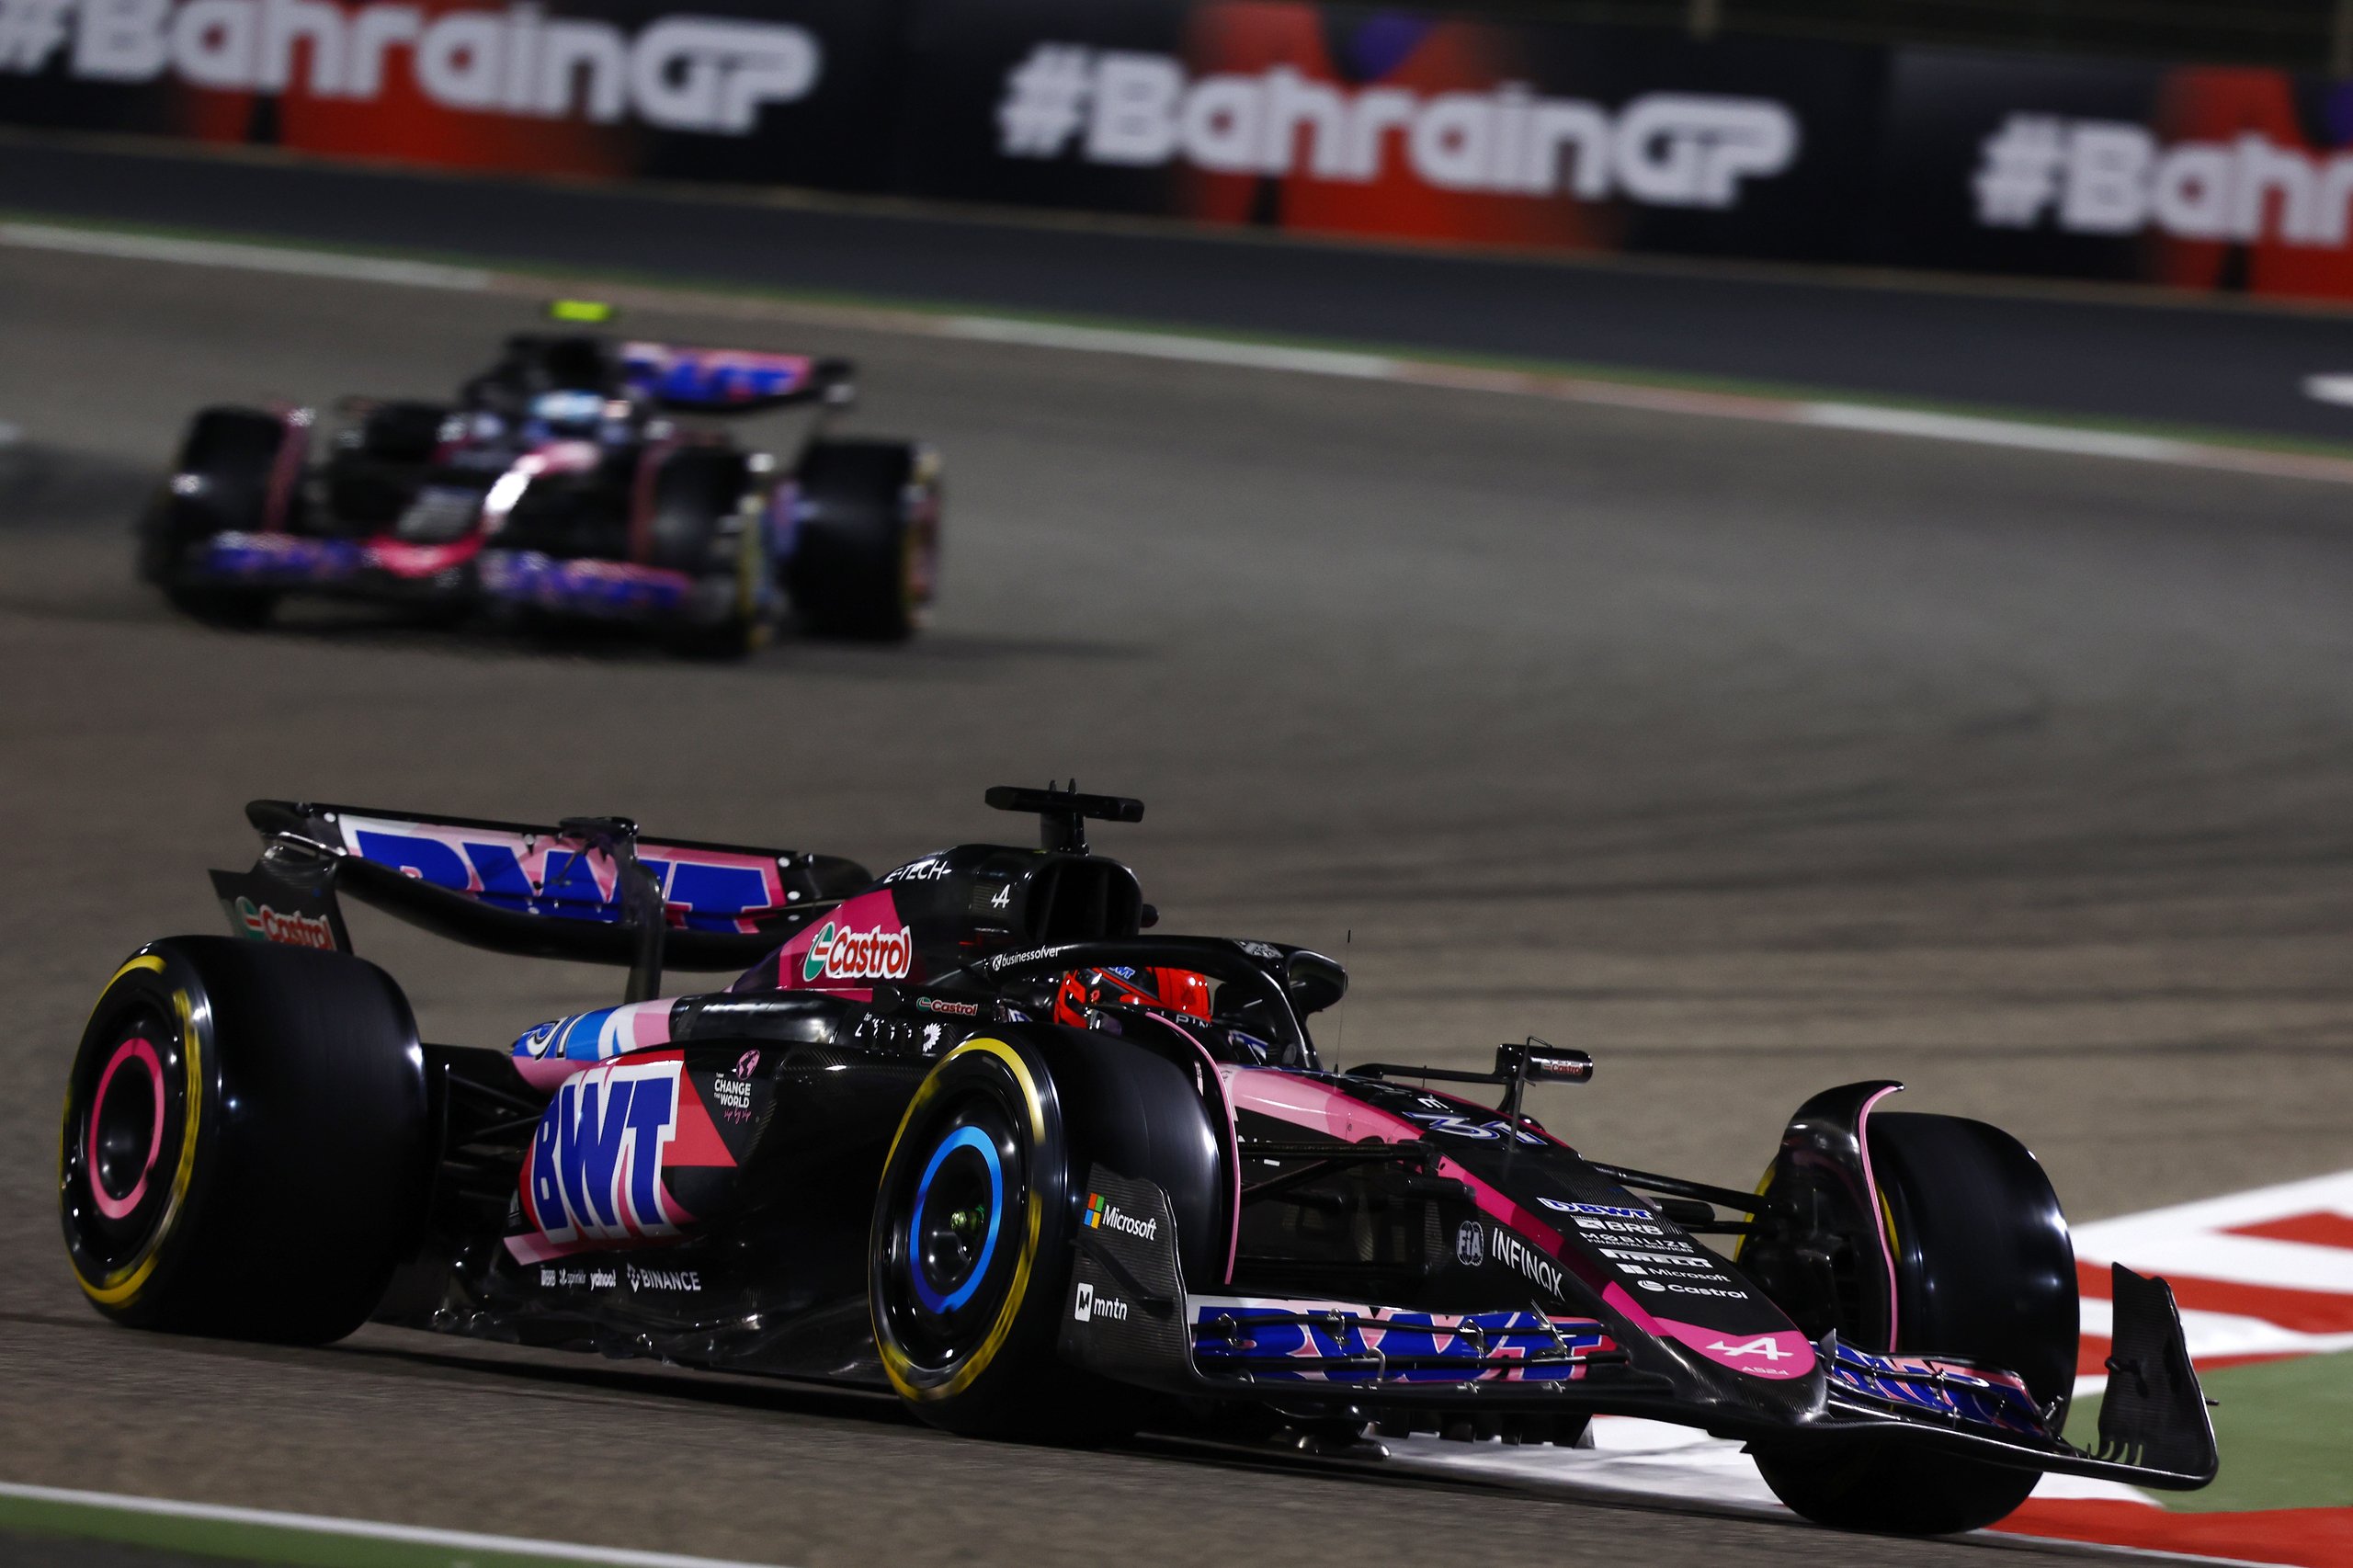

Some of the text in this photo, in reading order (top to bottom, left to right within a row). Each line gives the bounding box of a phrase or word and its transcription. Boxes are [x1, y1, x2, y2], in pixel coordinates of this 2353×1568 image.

[997, 41, 1797, 208] #BahrainGP
[260, 904, 337, 951] Castrol
[827, 925, 912, 980] Castrol
[1002, 945, 1059, 968] businessolver
[931, 999, 978, 1017] Castrol
[714, 1079, 751, 1096] CHANGE
[721, 1094, 749, 1108] WORLD
[1402, 1110, 1548, 1146] 31
[531, 1066, 680, 1238] BWT
[1102, 1204, 1157, 1241] Microsoft
[1575, 1202, 1654, 1221] BWT
[1606, 1221, 1665, 1236] BRB
[590, 1268, 617, 1291] yahoo!
[640, 1267, 701, 1291] BINANCE
[1648, 1267, 1732, 1282] Microsoft
[1667, 1283, 1749, 1300] Castrol
[1094, 1298, 1128, 1321] mntn
[1742, 1366, 1790, 1376] A524
